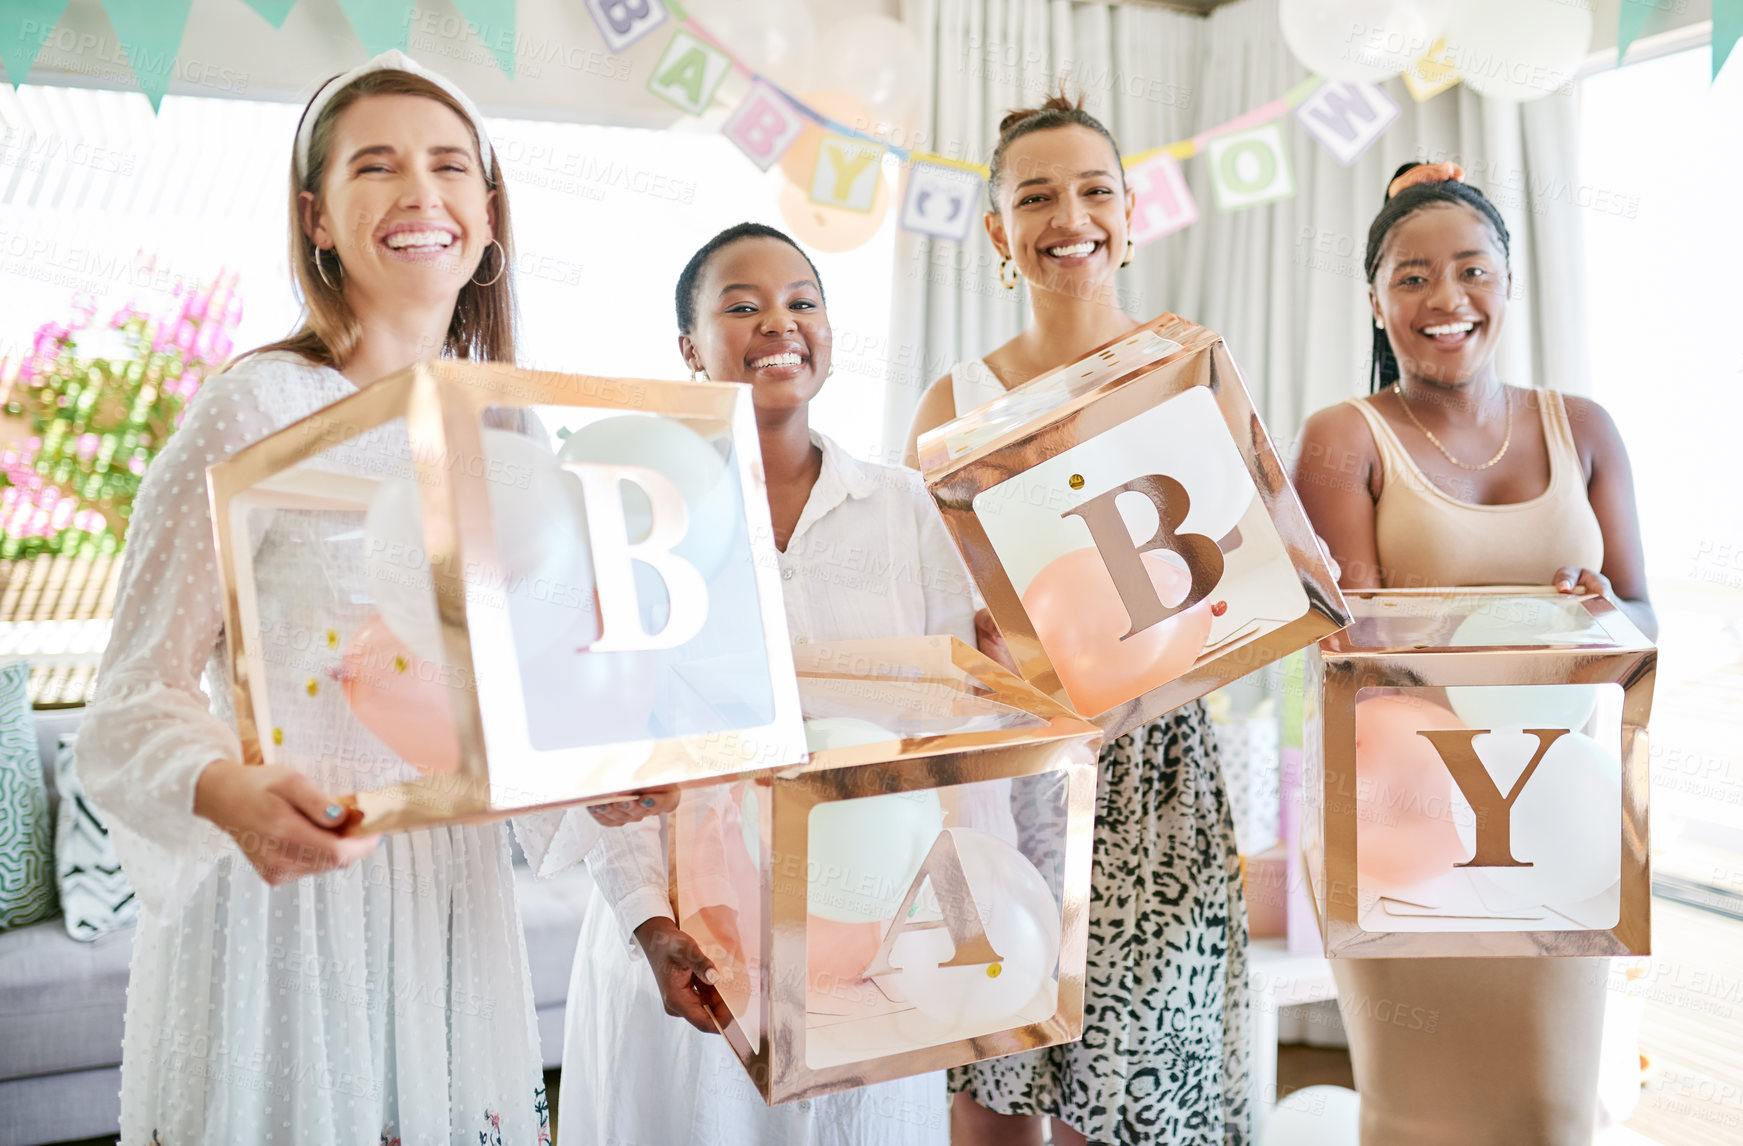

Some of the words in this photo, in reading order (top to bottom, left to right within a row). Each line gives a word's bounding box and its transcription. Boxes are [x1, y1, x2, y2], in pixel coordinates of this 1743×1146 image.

[561, 461, 710, 654] B
[1061, 473, 1225, 642] B
[1416, 729, 1571, 868] Y
[861, 829, 1004, 979] A
